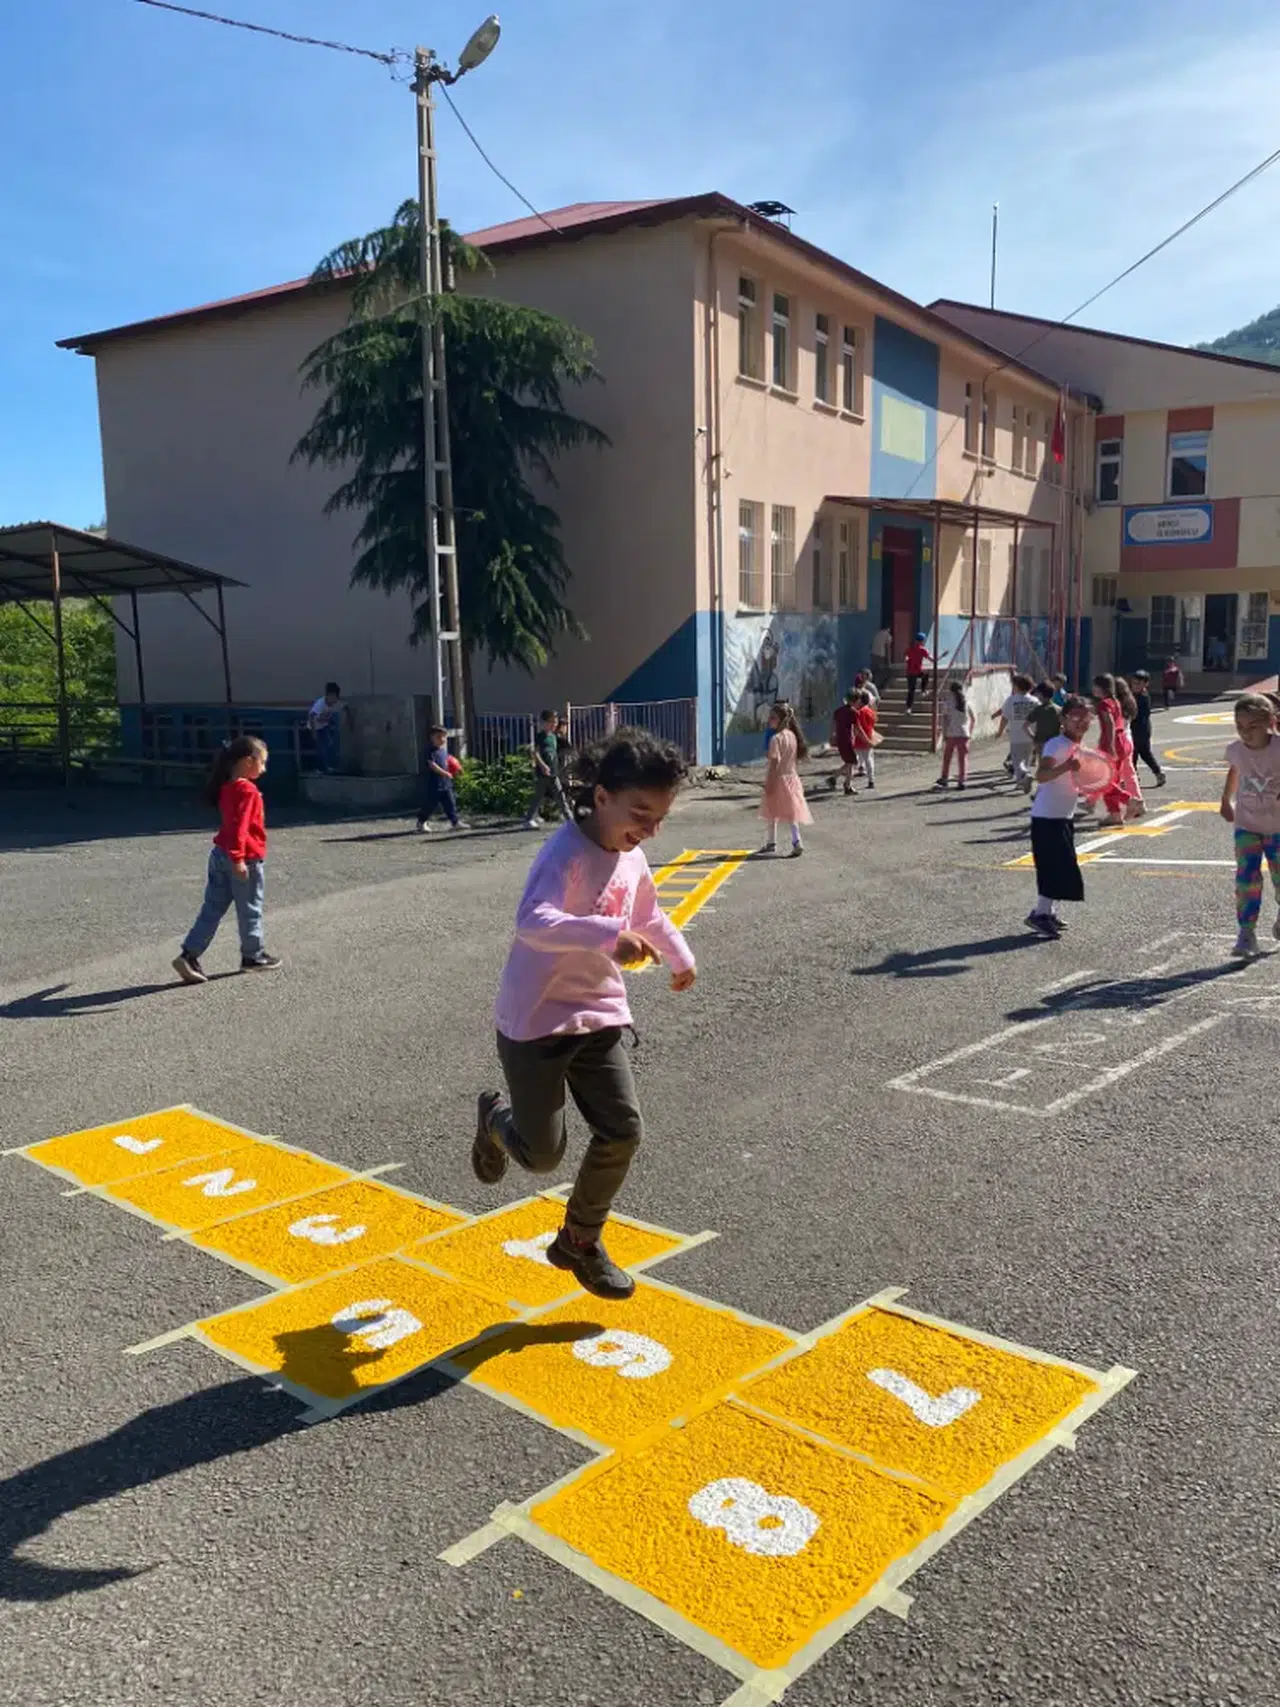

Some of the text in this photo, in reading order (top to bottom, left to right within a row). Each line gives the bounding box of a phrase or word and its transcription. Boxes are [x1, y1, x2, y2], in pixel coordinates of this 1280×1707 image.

[113, 1135, 163, 1154] 1
[183, 1168, 257, 1197] 2
[288, 1214, 366, 1245] 3
[331, 1298, 423, 1350] 5
[866, 1368, 982, 1427] 7
[689, 1477, 819, 1557] 8
